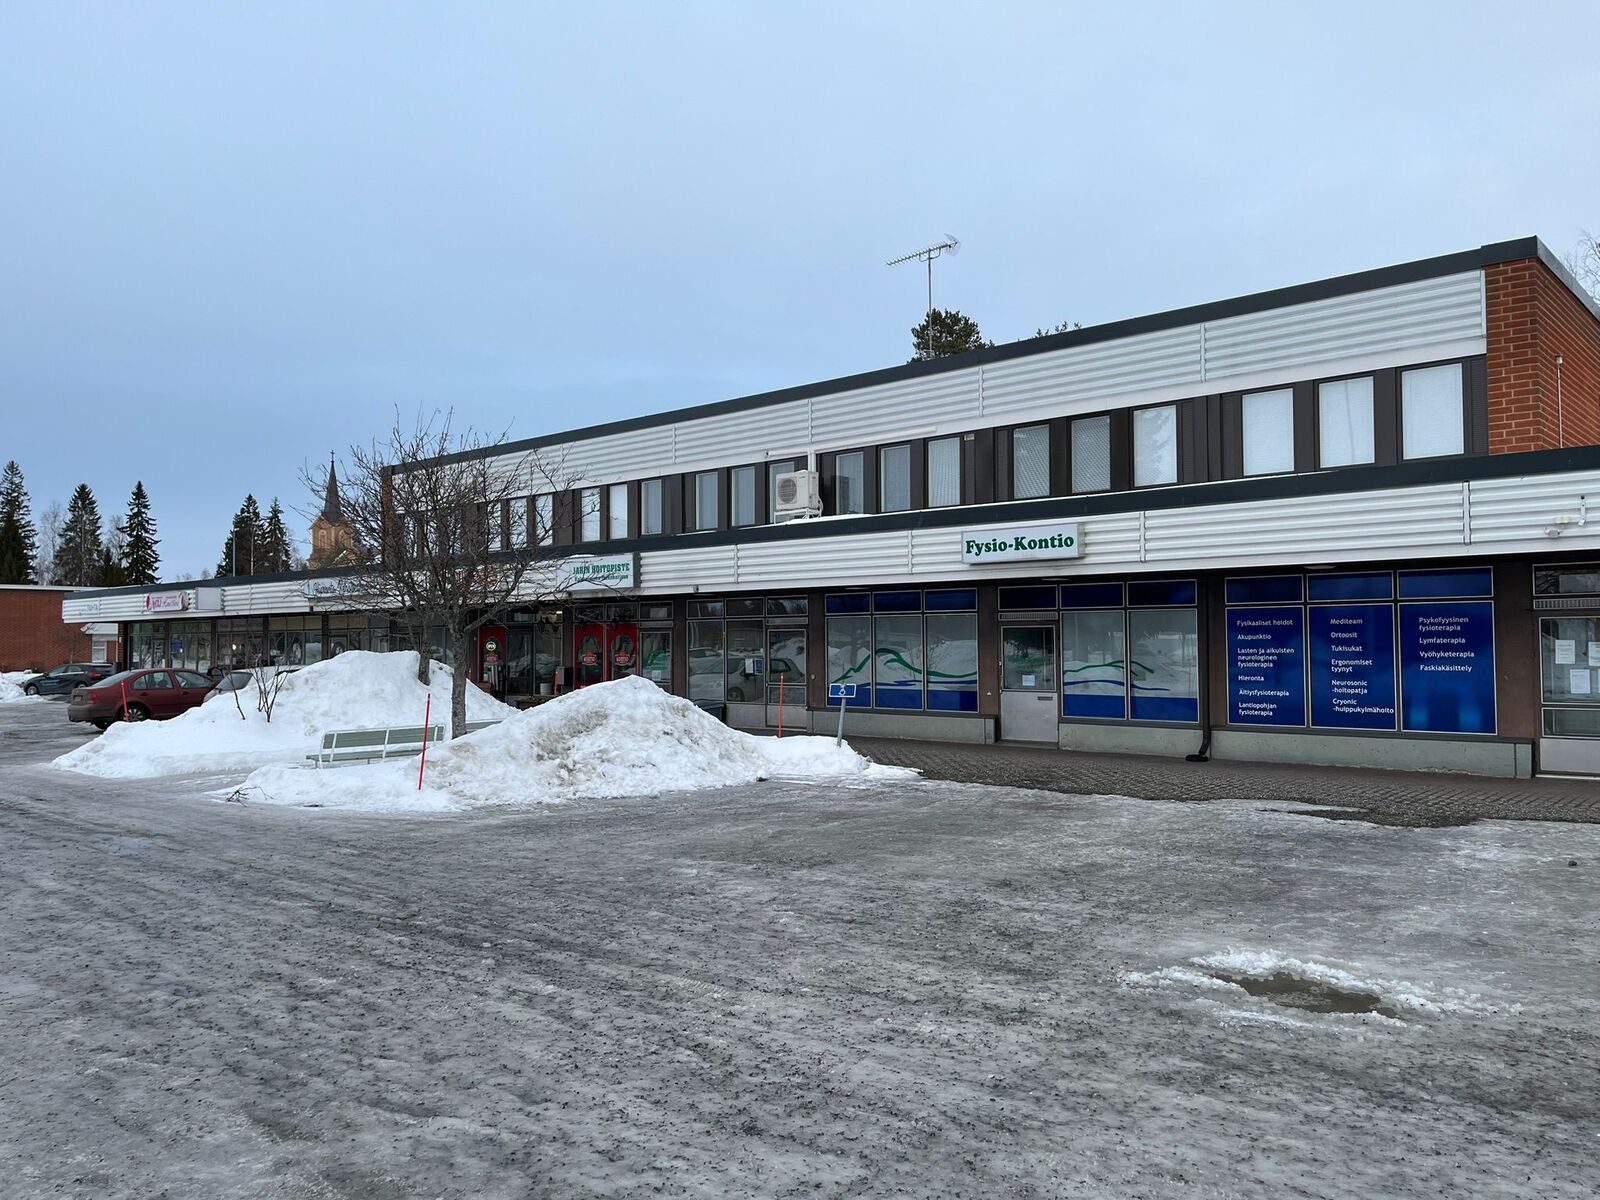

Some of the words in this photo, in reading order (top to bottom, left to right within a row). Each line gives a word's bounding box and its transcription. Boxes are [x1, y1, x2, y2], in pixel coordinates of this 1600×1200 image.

[965, 533, 1075, 557] Fysio-Kontio
[1418, 616, 1469, 624] Psykofyysinen
[1419, 624, 1461, 632] fysioterapia
[1419, 637, 1466, 645] Lymfaterapia
[1419, 651, 1475, 659] Vyöhyketerapia
[1331, 665, 1353, 673] tyynyt
[1420, 664, 1473, 672] Faskiakäsittely
[1239, 688, 1290, 696] Äitiysfysioterapia
[1332, 687, 1368, 695] -hoitopatja
[1332, 706, 1395, 714] -huippukylmähoito
